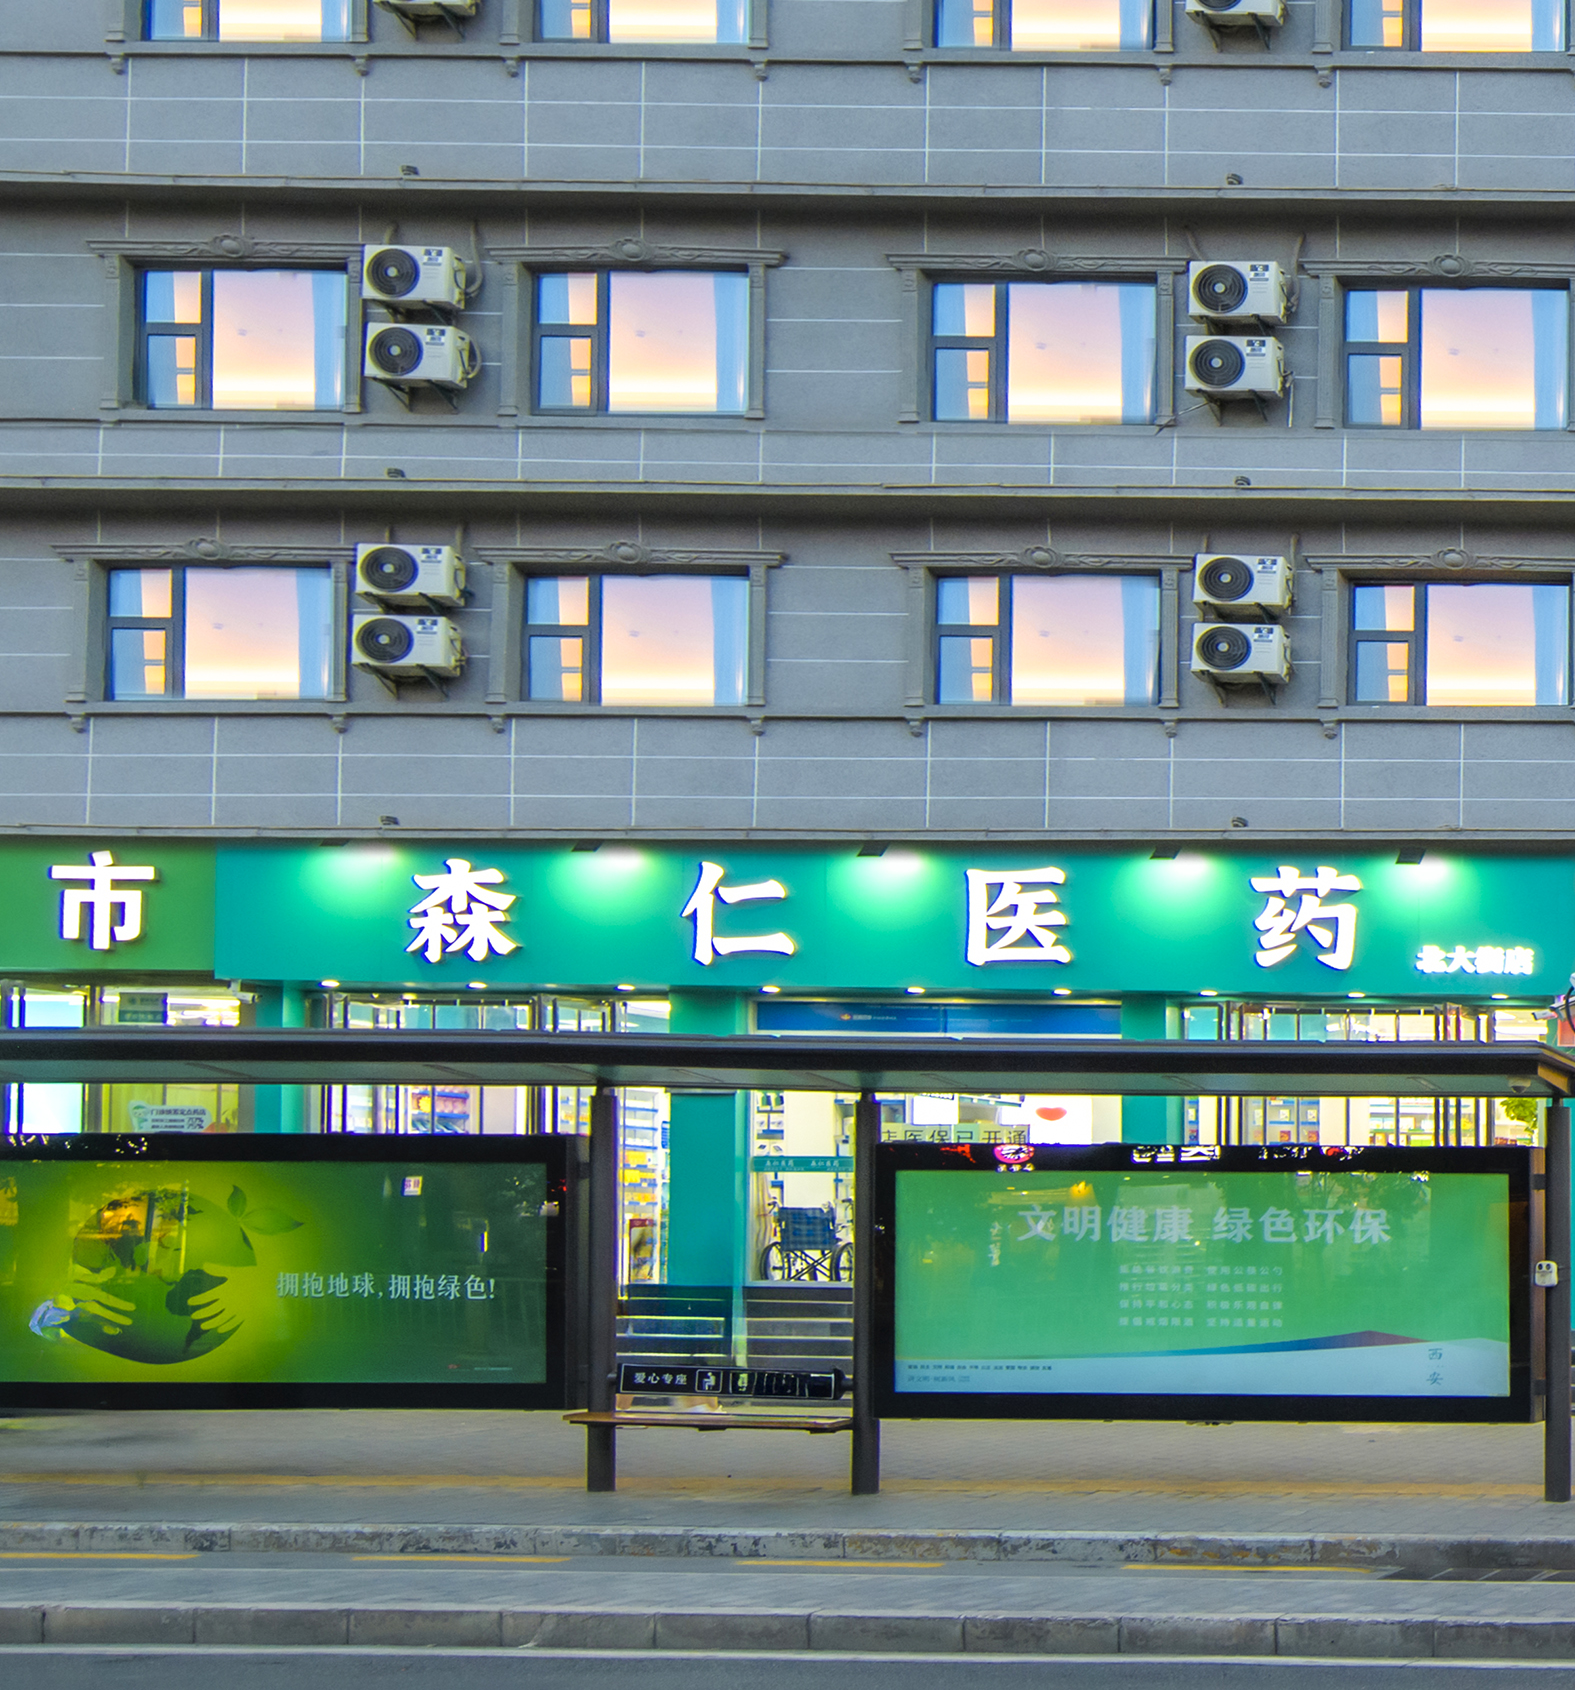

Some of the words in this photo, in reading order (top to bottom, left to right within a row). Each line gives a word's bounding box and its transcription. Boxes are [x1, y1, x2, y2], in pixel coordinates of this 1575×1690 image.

[49, 851, 156, 950] 市
[405, 857, 1363, 971] 森仁医药
[1416, 945, 1535, 975] 北大街店
[1017, 1204, 1194, 1244] 文明健康
[1212, 1206, 1392, 1245] 绿色环保
[633, 1371, 688, 1386] 爱心专座
[1426, 1348, 1443, 1385] 西安
